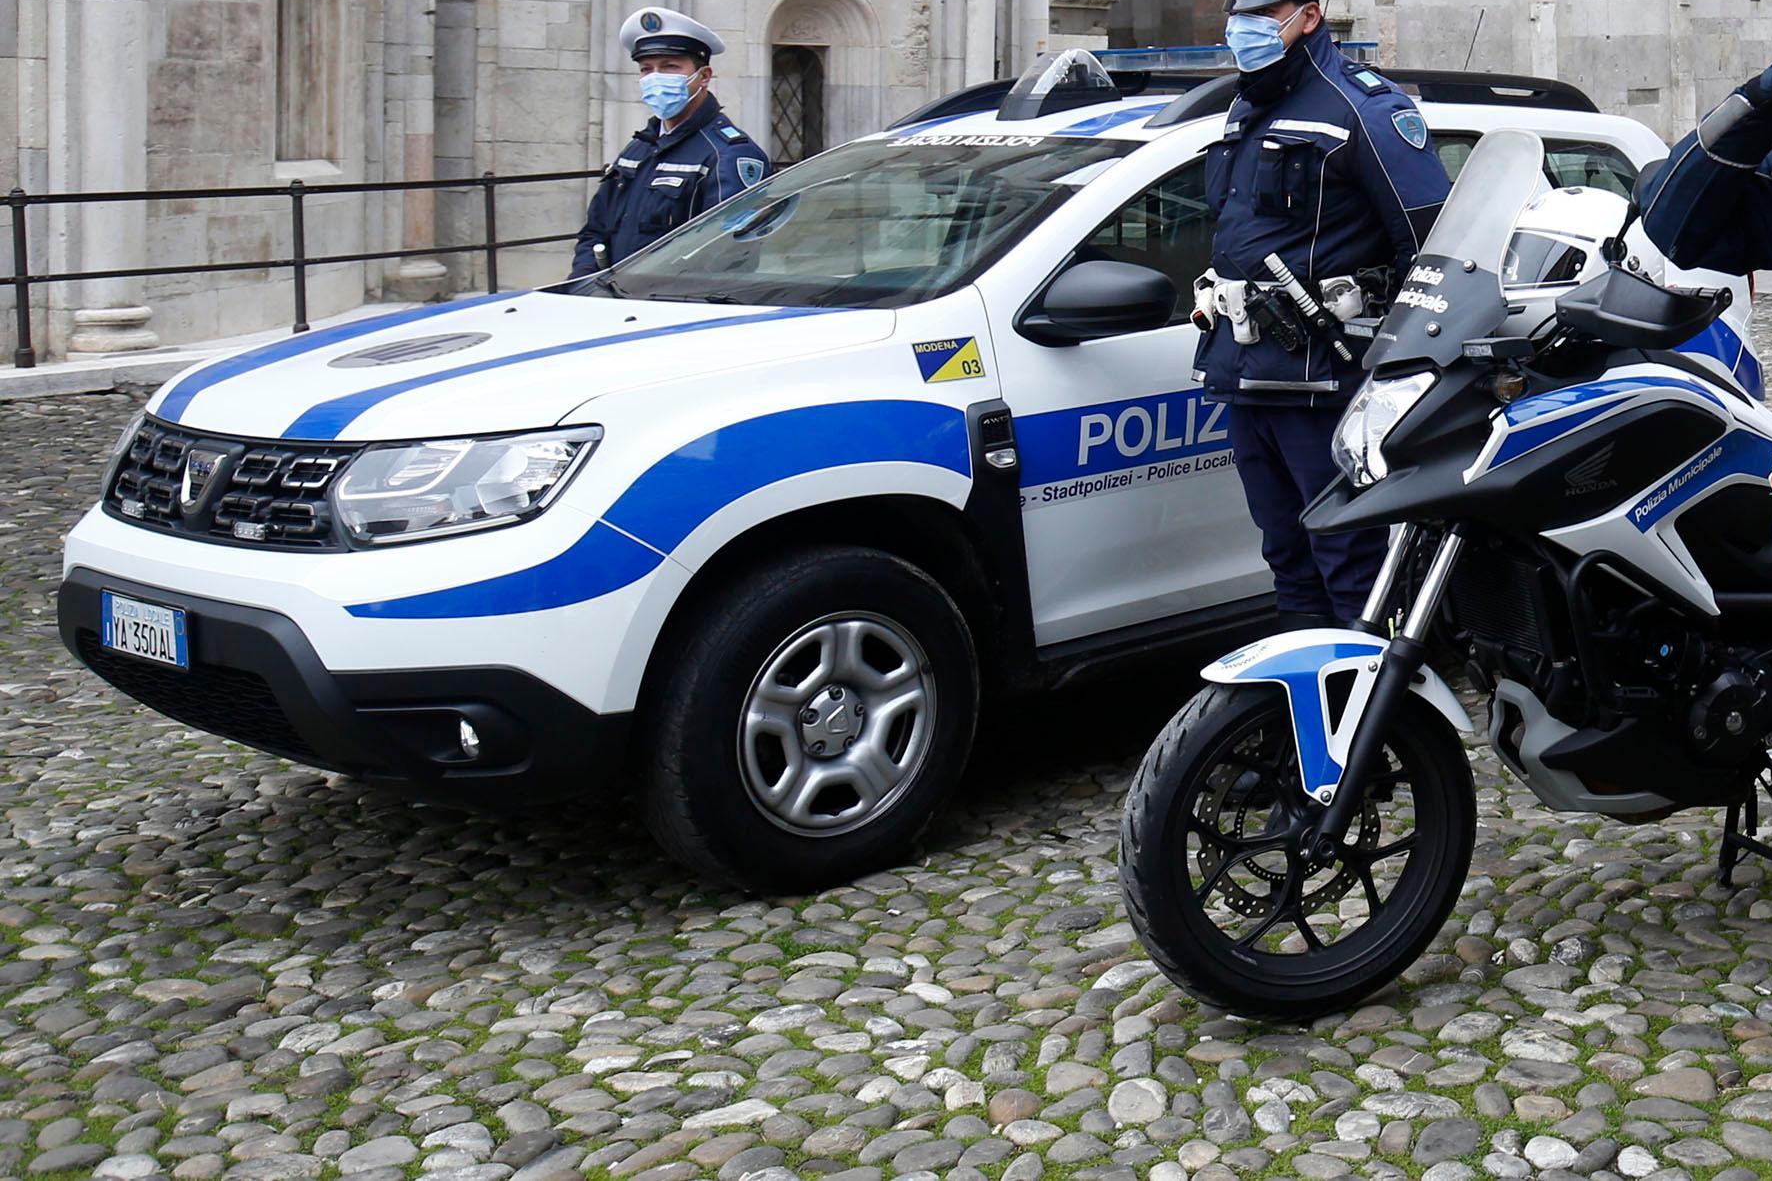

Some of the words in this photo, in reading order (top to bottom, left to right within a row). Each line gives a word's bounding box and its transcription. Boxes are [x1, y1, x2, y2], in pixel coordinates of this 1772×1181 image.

[914, 340, 959, 354] MODENA
[961, 359, 982, 376] 03
[1077, 397, 1229, 467] POLIZ
[1042, 469, 1134, 503] Stadtpolizei
[1147, 458, 1191, 482] Police
[1565, 479, 1618, 498] HONDA
[1634, 489, 1668, 523] Polizia
[1668, 445, 1723, 496] Municipale
